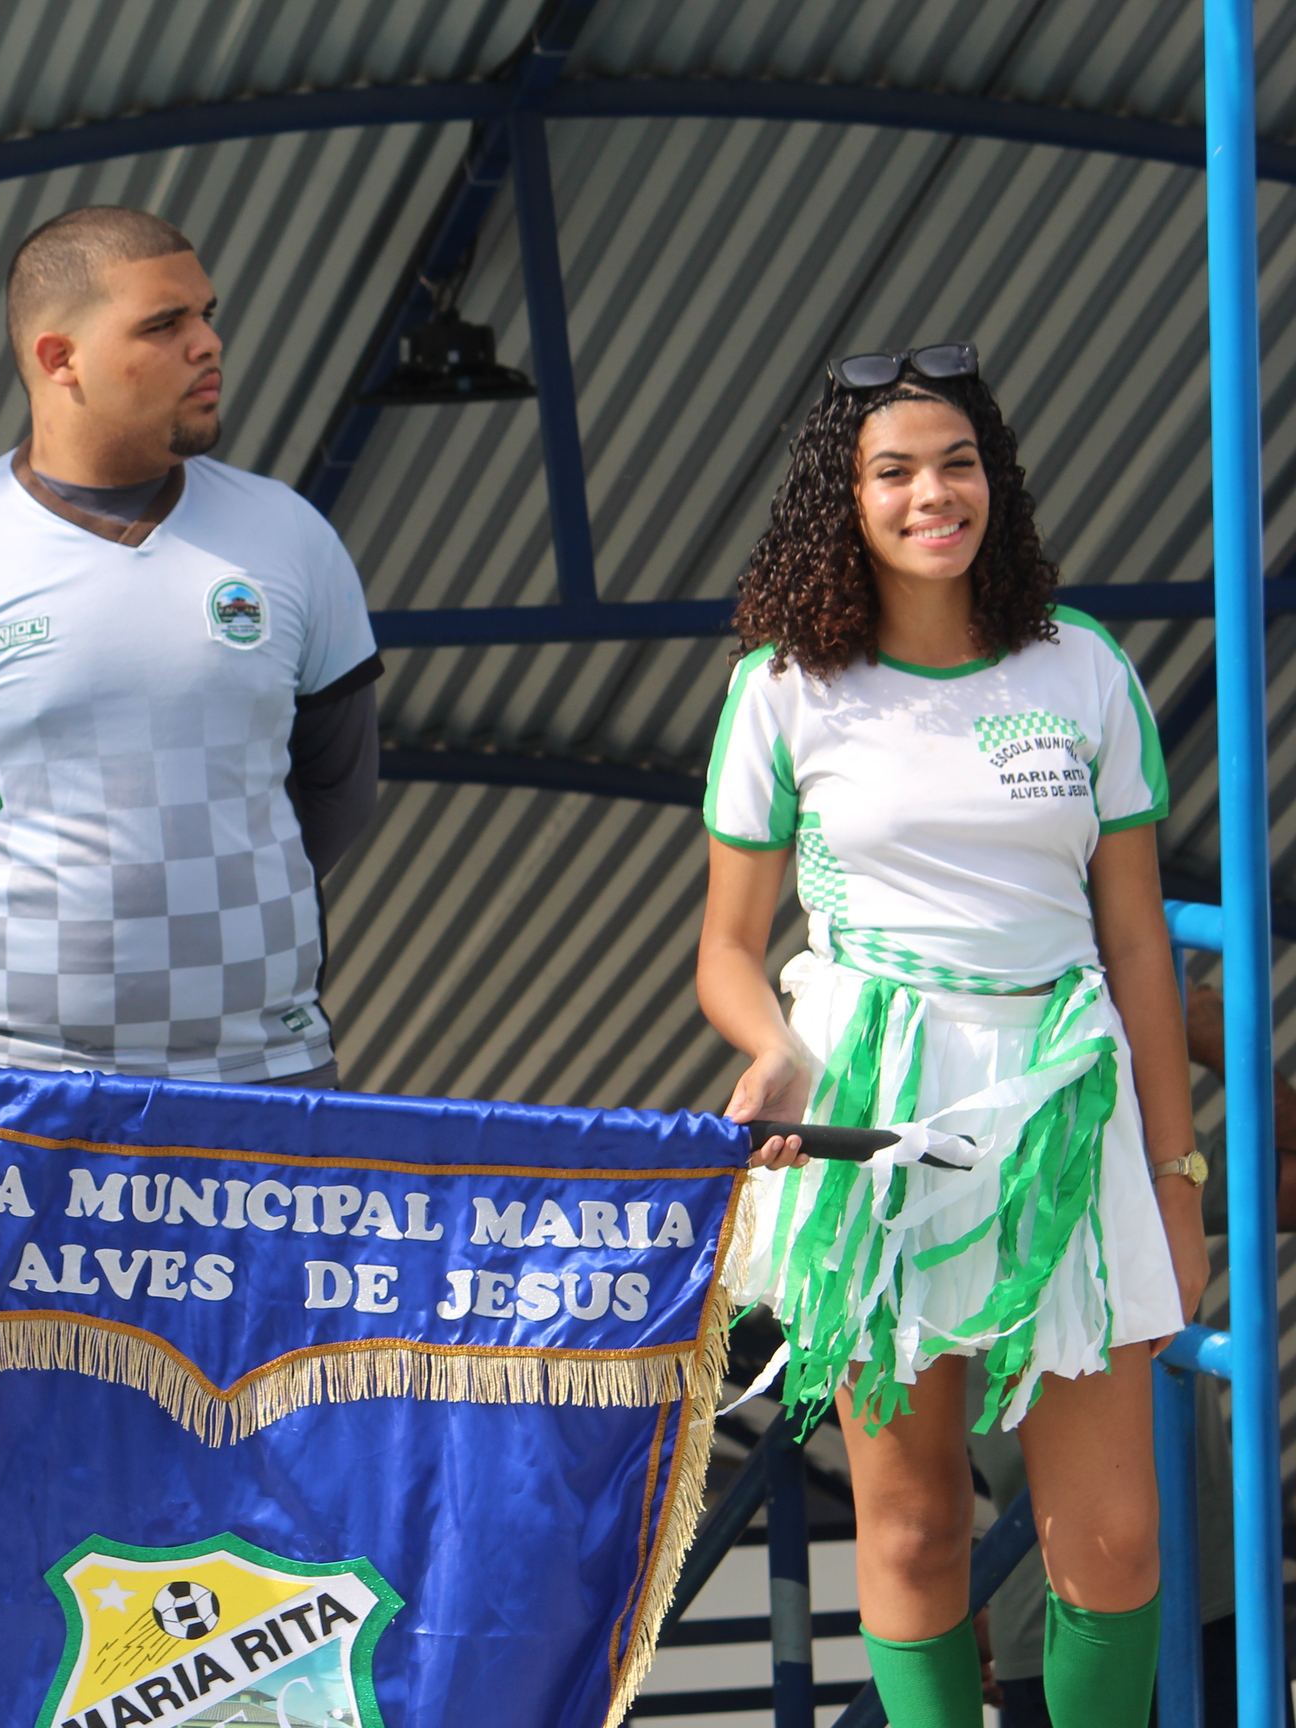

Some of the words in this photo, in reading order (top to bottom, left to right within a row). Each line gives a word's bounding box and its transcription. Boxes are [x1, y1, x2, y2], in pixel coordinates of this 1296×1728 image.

[989, 738, 1033, 769] ESCOLA
[1034, 736, 1079, 764] MUNICI
[999, 770, 1060, 785] MARIA
[1062, 769, 1085, 781] RITA
[1010, 785, 1048, 800] ALVES
[1050, 785, 1065, 797] DE
[65, 1168, 444, 1242] MUNICIPAL
[470, 1197, 695, 1249] MARIA
[9, 1242, 235, 1301] ALVES
[304, 1260, 399, 1314] DE
[436, 1269, 650, 1322] JESUS
[230, 1592, 358, 1672] RITA
